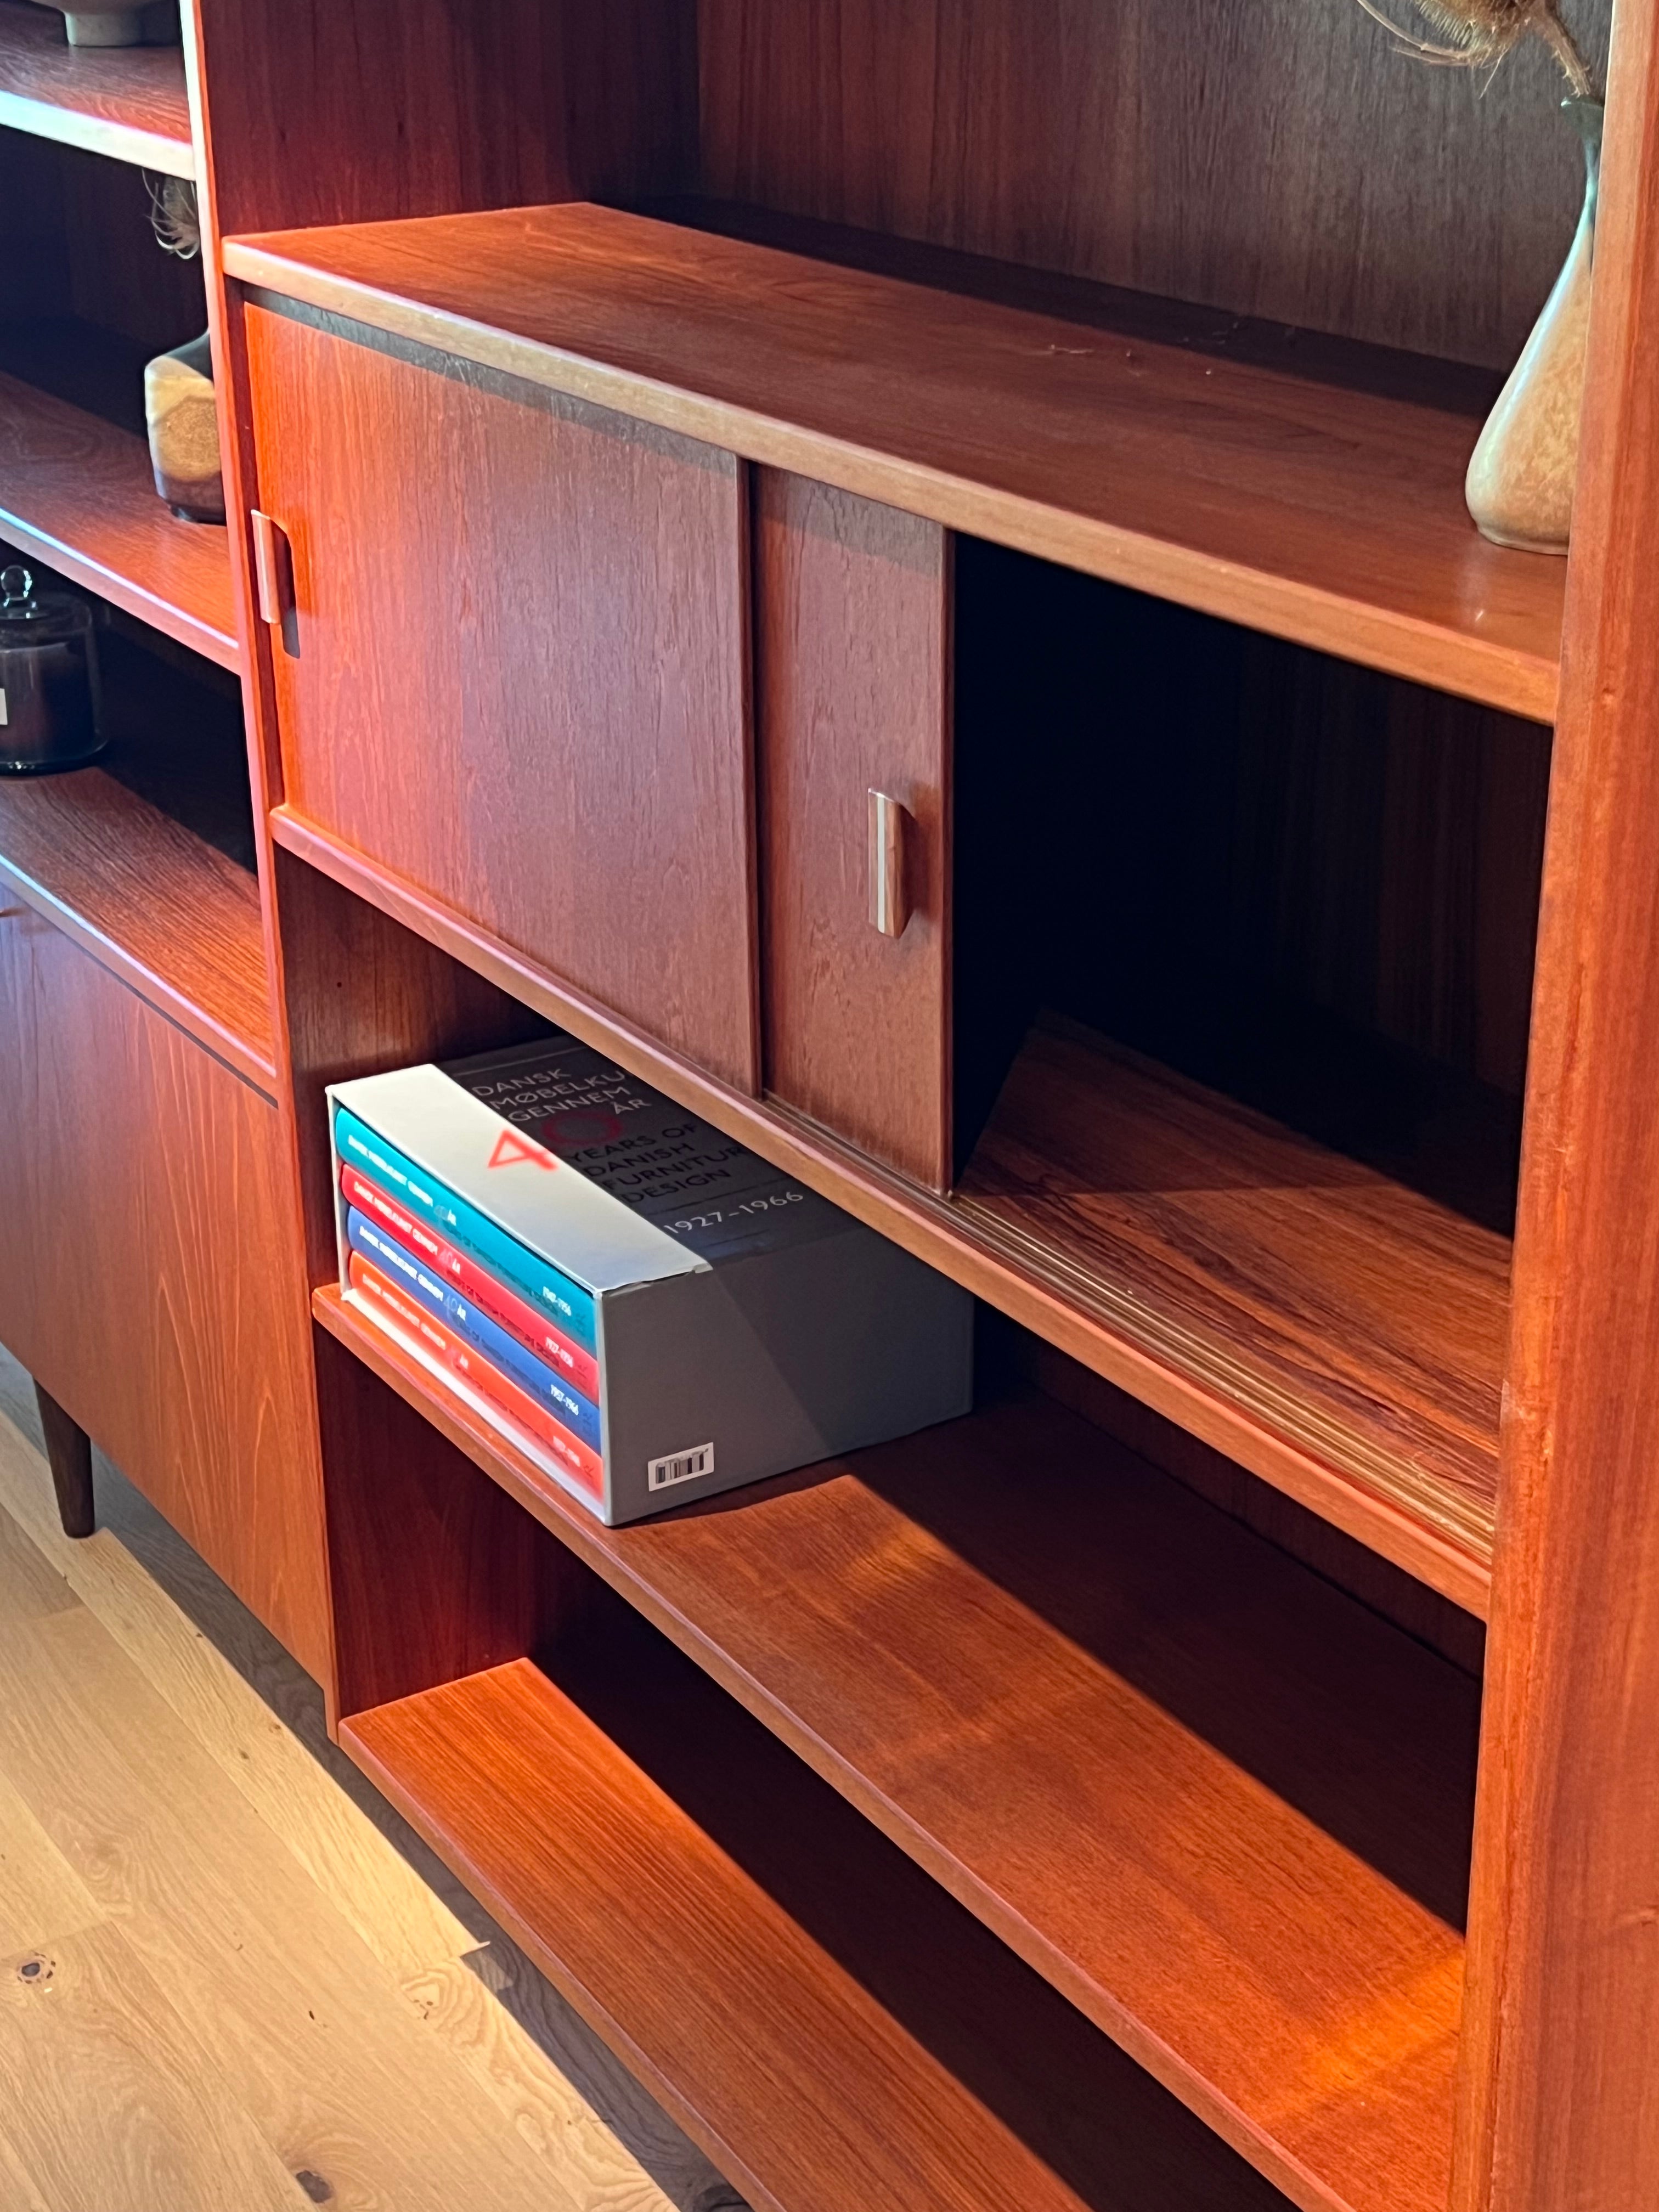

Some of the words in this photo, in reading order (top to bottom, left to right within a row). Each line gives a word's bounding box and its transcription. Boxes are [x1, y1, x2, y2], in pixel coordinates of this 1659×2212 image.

[471, 1069, 571, 1096] DANSK
[507, 1086, 631, 1121] GENNEM
[562, 1135, 657, 1163] YEARS
[662, 1122, 697, 1138] OF
[583, 1143, 696, 1177] DANISH
[620, 1169, 732, 1204] DESIGN
[664, 1191, 804, 1234] 1927-1966
